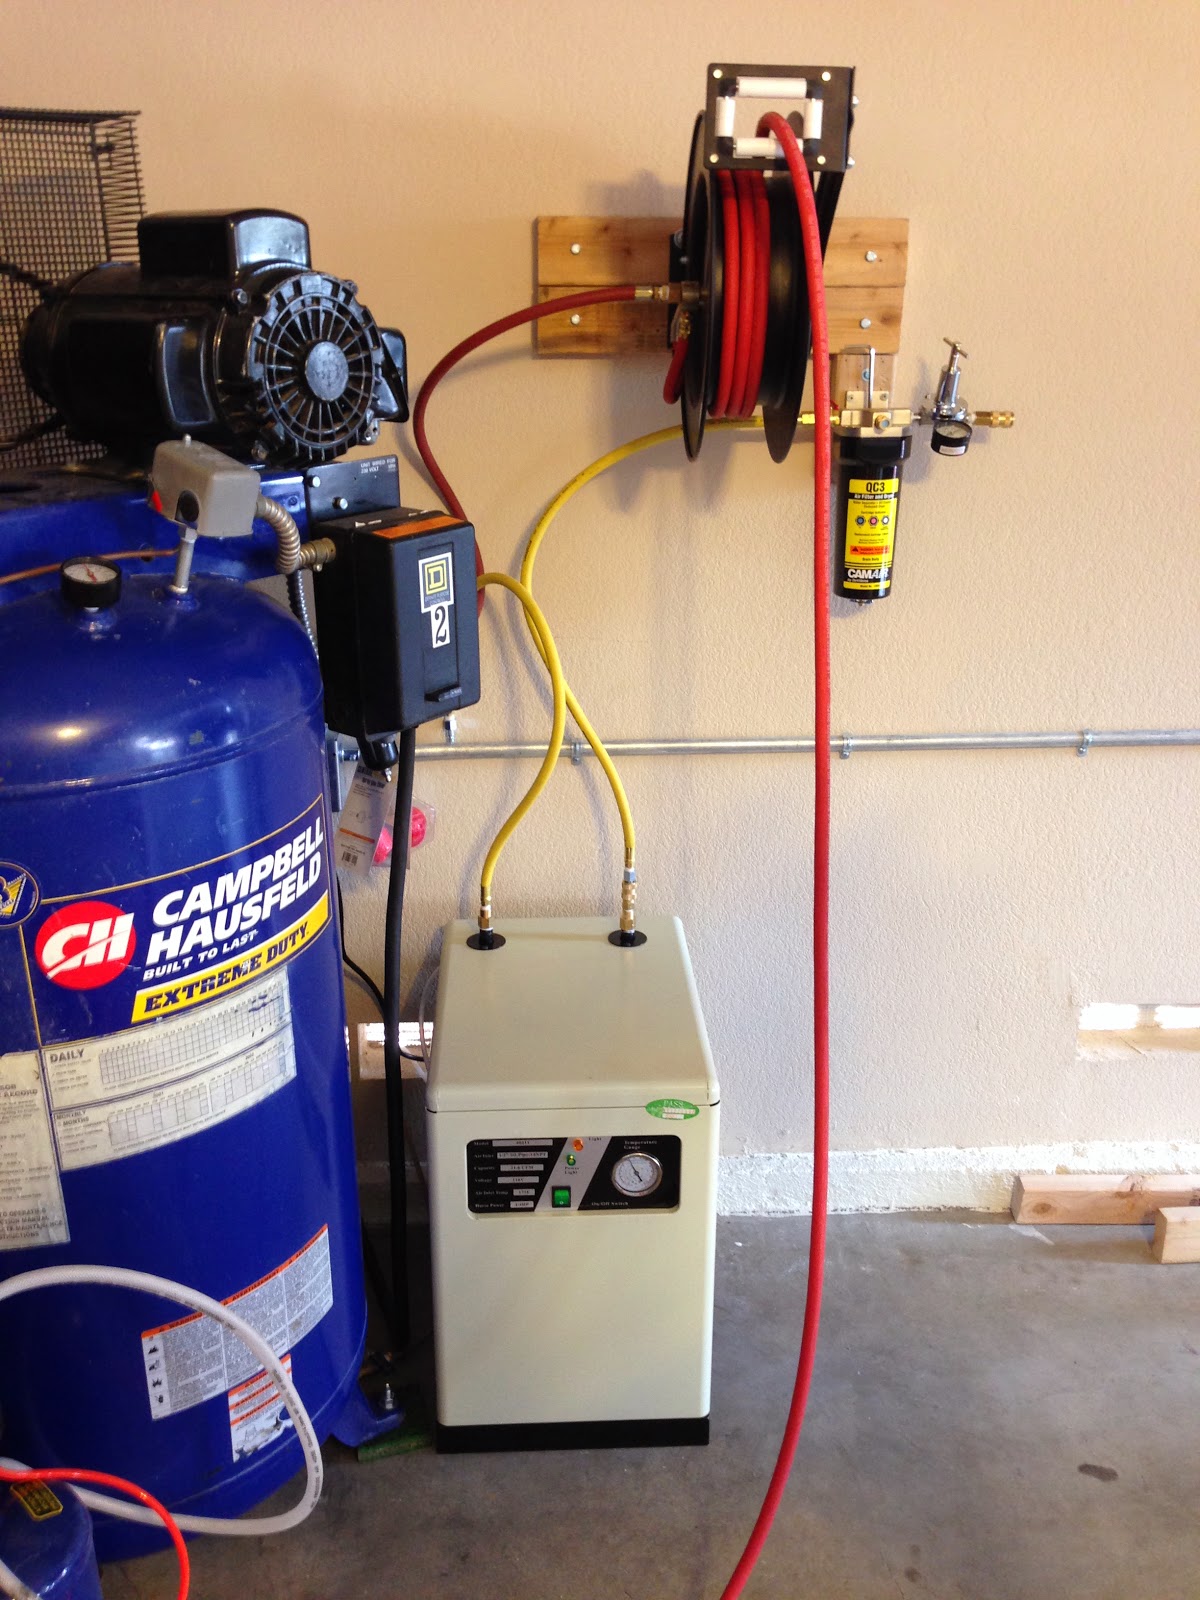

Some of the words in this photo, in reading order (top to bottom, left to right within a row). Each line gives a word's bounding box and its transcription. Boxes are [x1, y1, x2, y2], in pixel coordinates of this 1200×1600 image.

[866, 482, 885, 493] QC3
[434, 605, 447, 645] 2
[152, 816, 324, 927] CAMPBELL
[145, 851, 322, 967] HAUSFELD
[143, 956, 193, 982] BUILT
[198, 948, 218, 963] TO
[144, 952, 263, 1013] EXTREME
[266, 921, 308, 963] DUTY
[50, 1048, 84, 1063] DAILY
